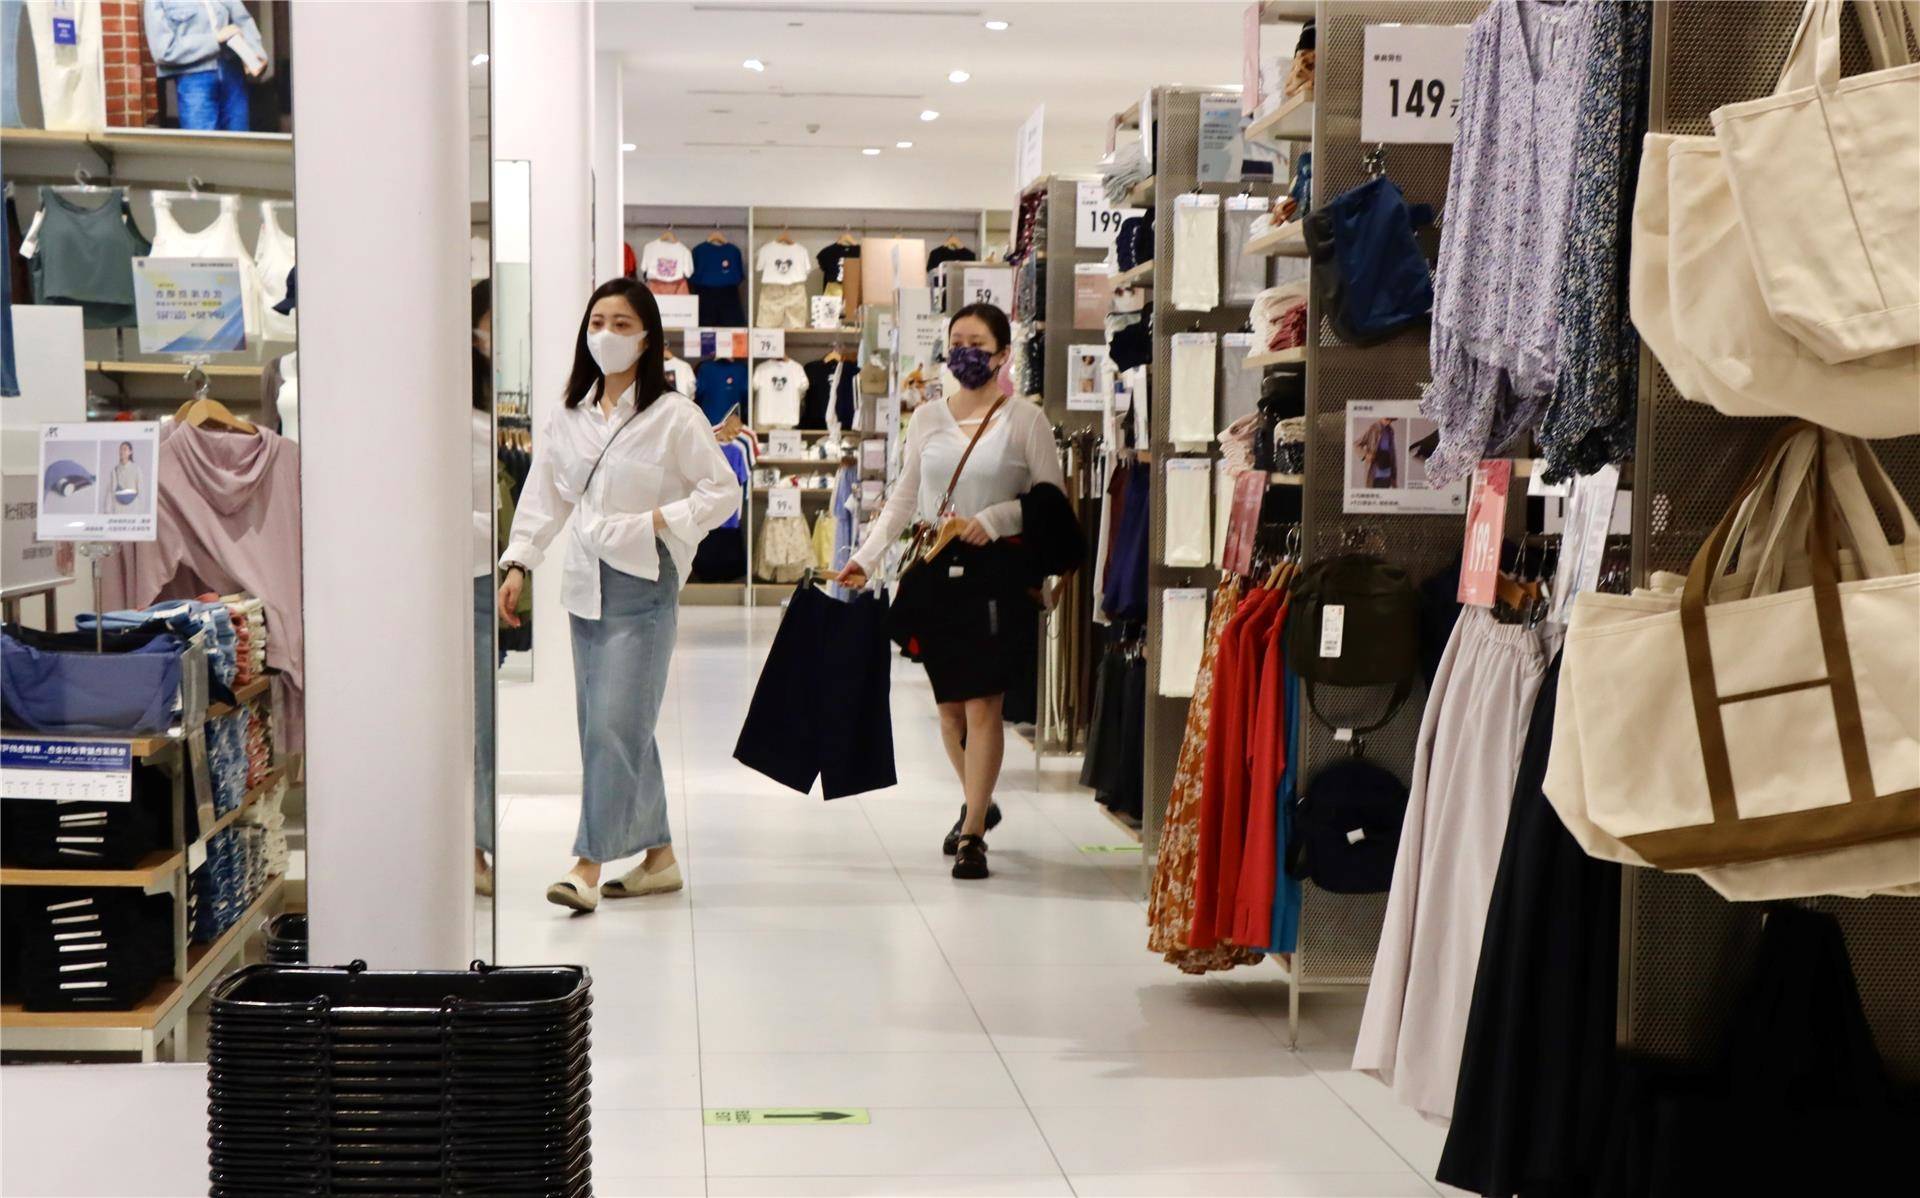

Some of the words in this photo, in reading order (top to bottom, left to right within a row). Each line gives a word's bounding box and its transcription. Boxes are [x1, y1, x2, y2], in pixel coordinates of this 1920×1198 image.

[1389, 79, 1445, 118] 149
[1090, 211, 1122, 233] 199
[976, 288, 992, 305] 59
[760, 340, 771, 352] 79
[777, 442, 788, 453] 79
[1469, 521, 1490, 573] 199
